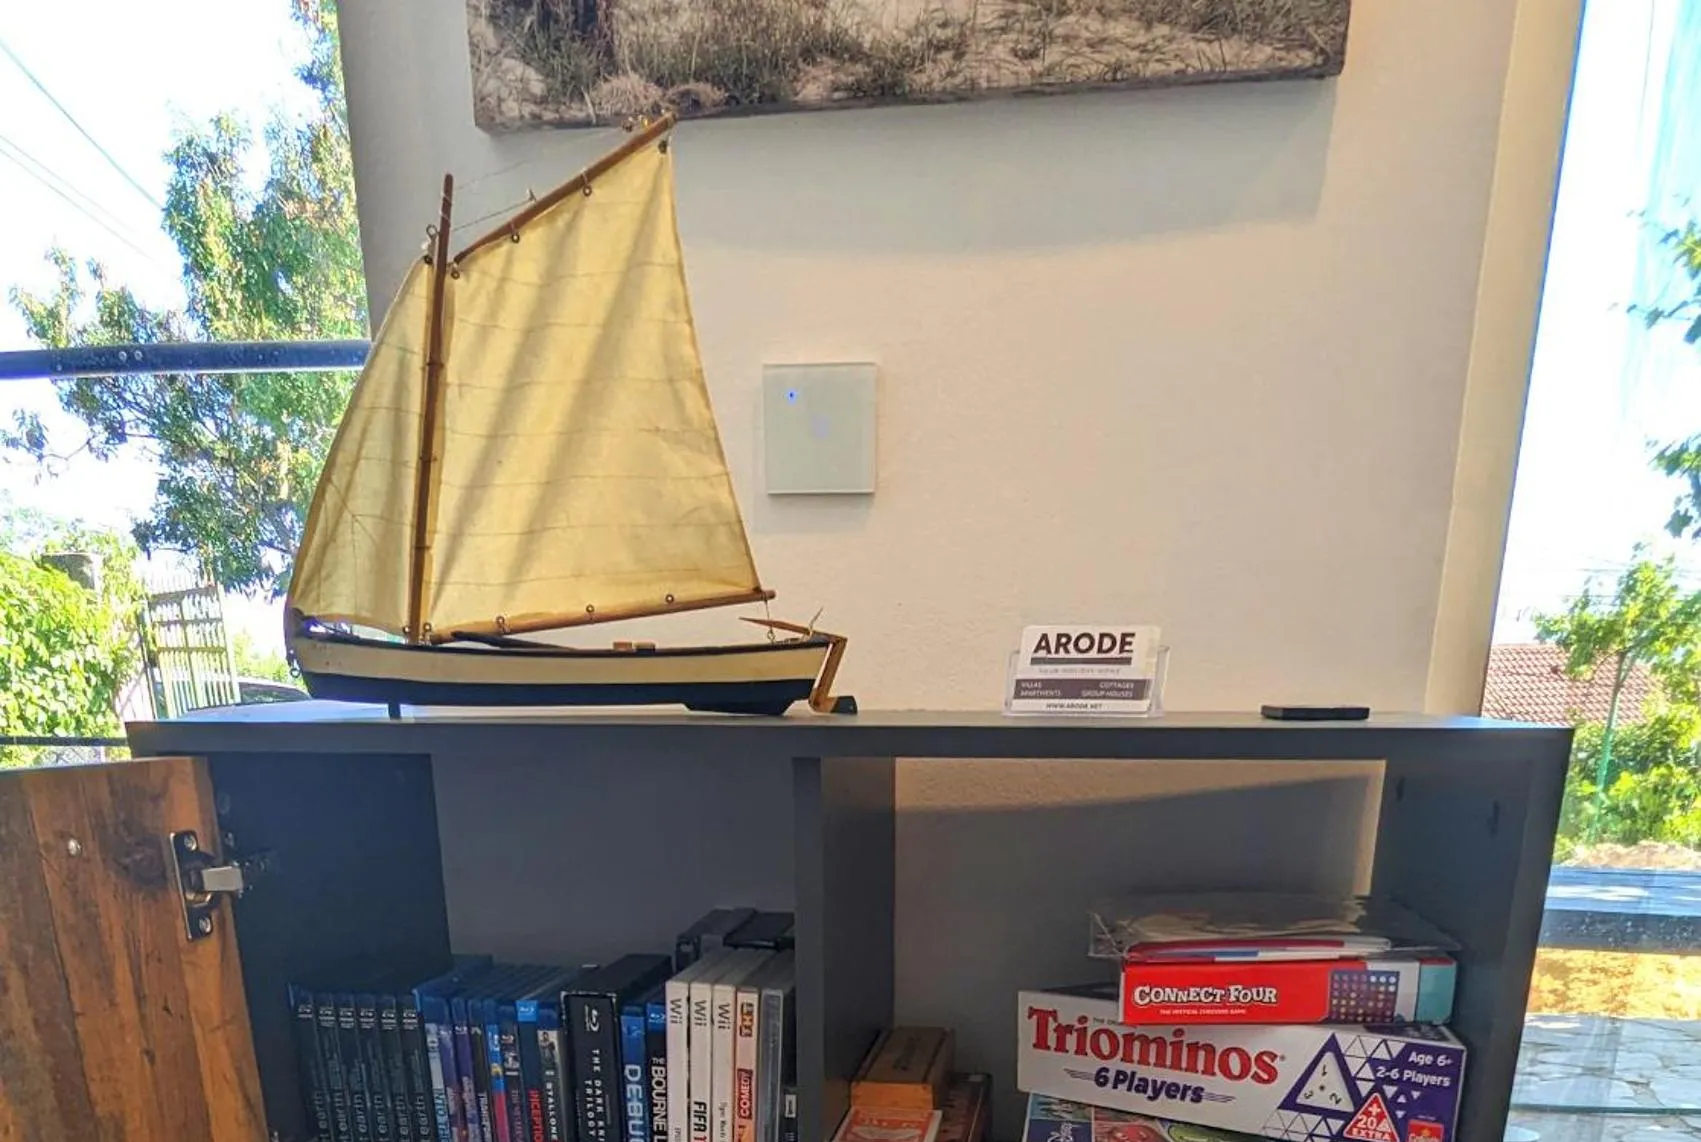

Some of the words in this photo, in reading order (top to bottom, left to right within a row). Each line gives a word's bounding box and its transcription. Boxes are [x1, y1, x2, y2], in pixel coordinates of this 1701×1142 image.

[1033, 632, 1136, 655] ARODE
[670, 998, 683, 1025] Wii
[694, 1000, 707, 1027] Wii
[718, 1003, 730, 1030] Wii
[1028, 1006, 1280, 1085] Triominos
[1408, 1051, 1433, 1068] Age
[1094, 1067, 1108, 1088] 6
[1112, 1068, 1205, 1104] Players
[1376, 1066, 1400, 1080] 2-6
[1403, 1068, 1451, 1089] Players
[651, 1066, 667, 1132] BOURNE
[694, 1100, 707, 1133] FIFA
[1357, 1116, 1377, 1129] 20
[1352, 1128, 1392, 1142] EXTRA
